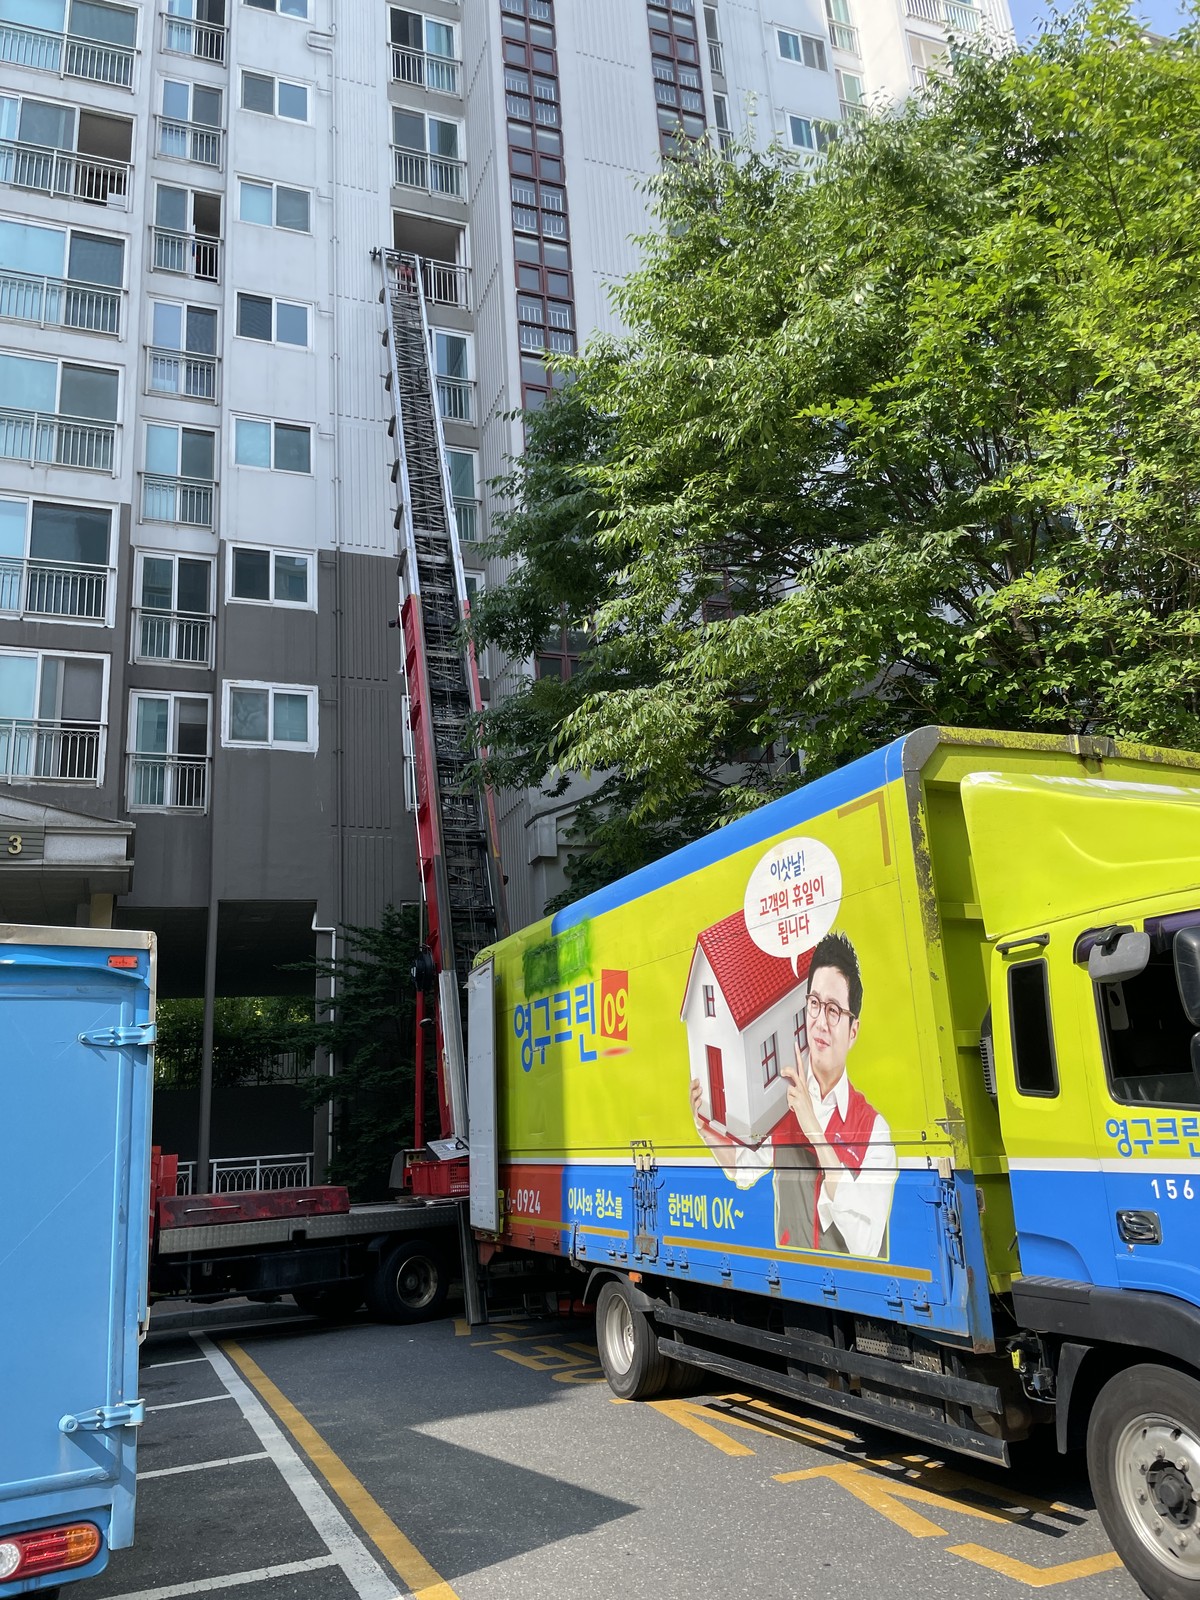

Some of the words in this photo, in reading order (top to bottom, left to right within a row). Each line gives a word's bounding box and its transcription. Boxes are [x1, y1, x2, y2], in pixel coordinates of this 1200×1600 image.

[8, 834, 23, 855] 3
[770, 850, 806, 882] 이삿날!
[759, 888, 789, 916] 고객의
[792, 875, 825, 907] 휴일이
[777, 913, 810, 946] 됩니다
[513, 981, 598, 1073] 영구크린
[603, 988, 629, 1035] 09
[1150, 1178, 1195, 1200] 156
[567, 1187, 593, 1216] 이사와
[595, 1188, 623, 1219] 청소를
[667, 1192, 708, 1230] 한번에
